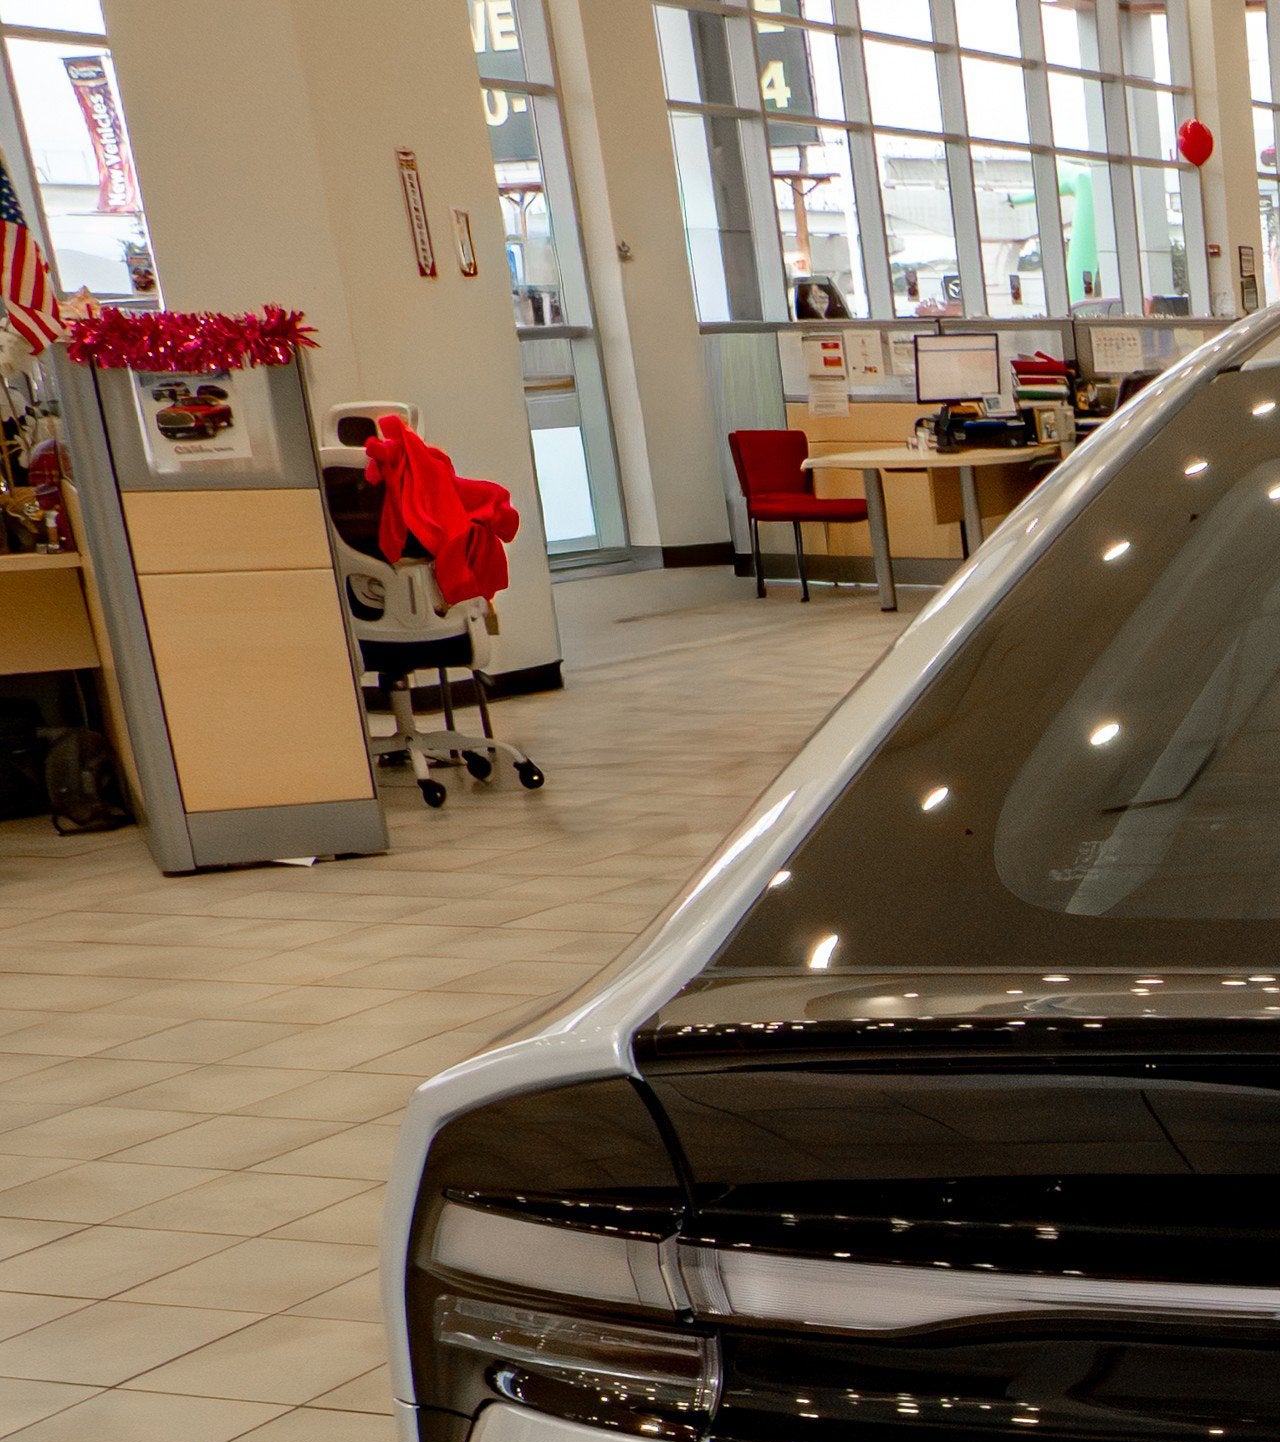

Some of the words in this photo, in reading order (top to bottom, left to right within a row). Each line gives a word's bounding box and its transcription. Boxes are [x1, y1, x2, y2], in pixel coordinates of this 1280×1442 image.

[760, 60, 792, 108] 4
[90, 93, 123, 168] Vehicles
[108, 168, 127, 206] New
